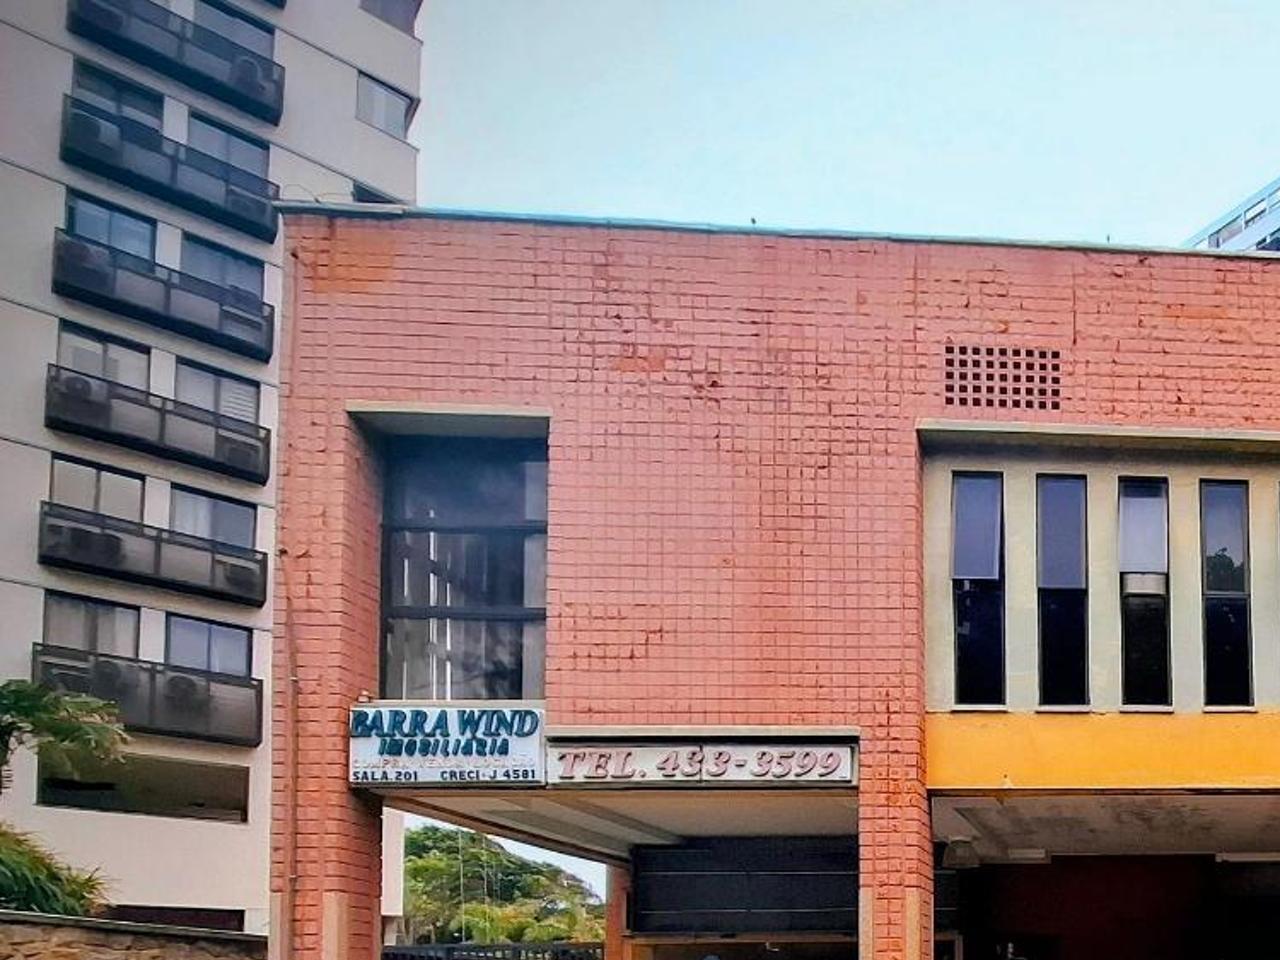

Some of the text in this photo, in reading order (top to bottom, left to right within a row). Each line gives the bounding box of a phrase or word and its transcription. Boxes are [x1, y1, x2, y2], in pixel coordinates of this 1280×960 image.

[350, 709, 540, 738] BARRA WIND
[502, 768, 536, 780] 4581
[557, 750, 842, 780] TEL. 433-3599
